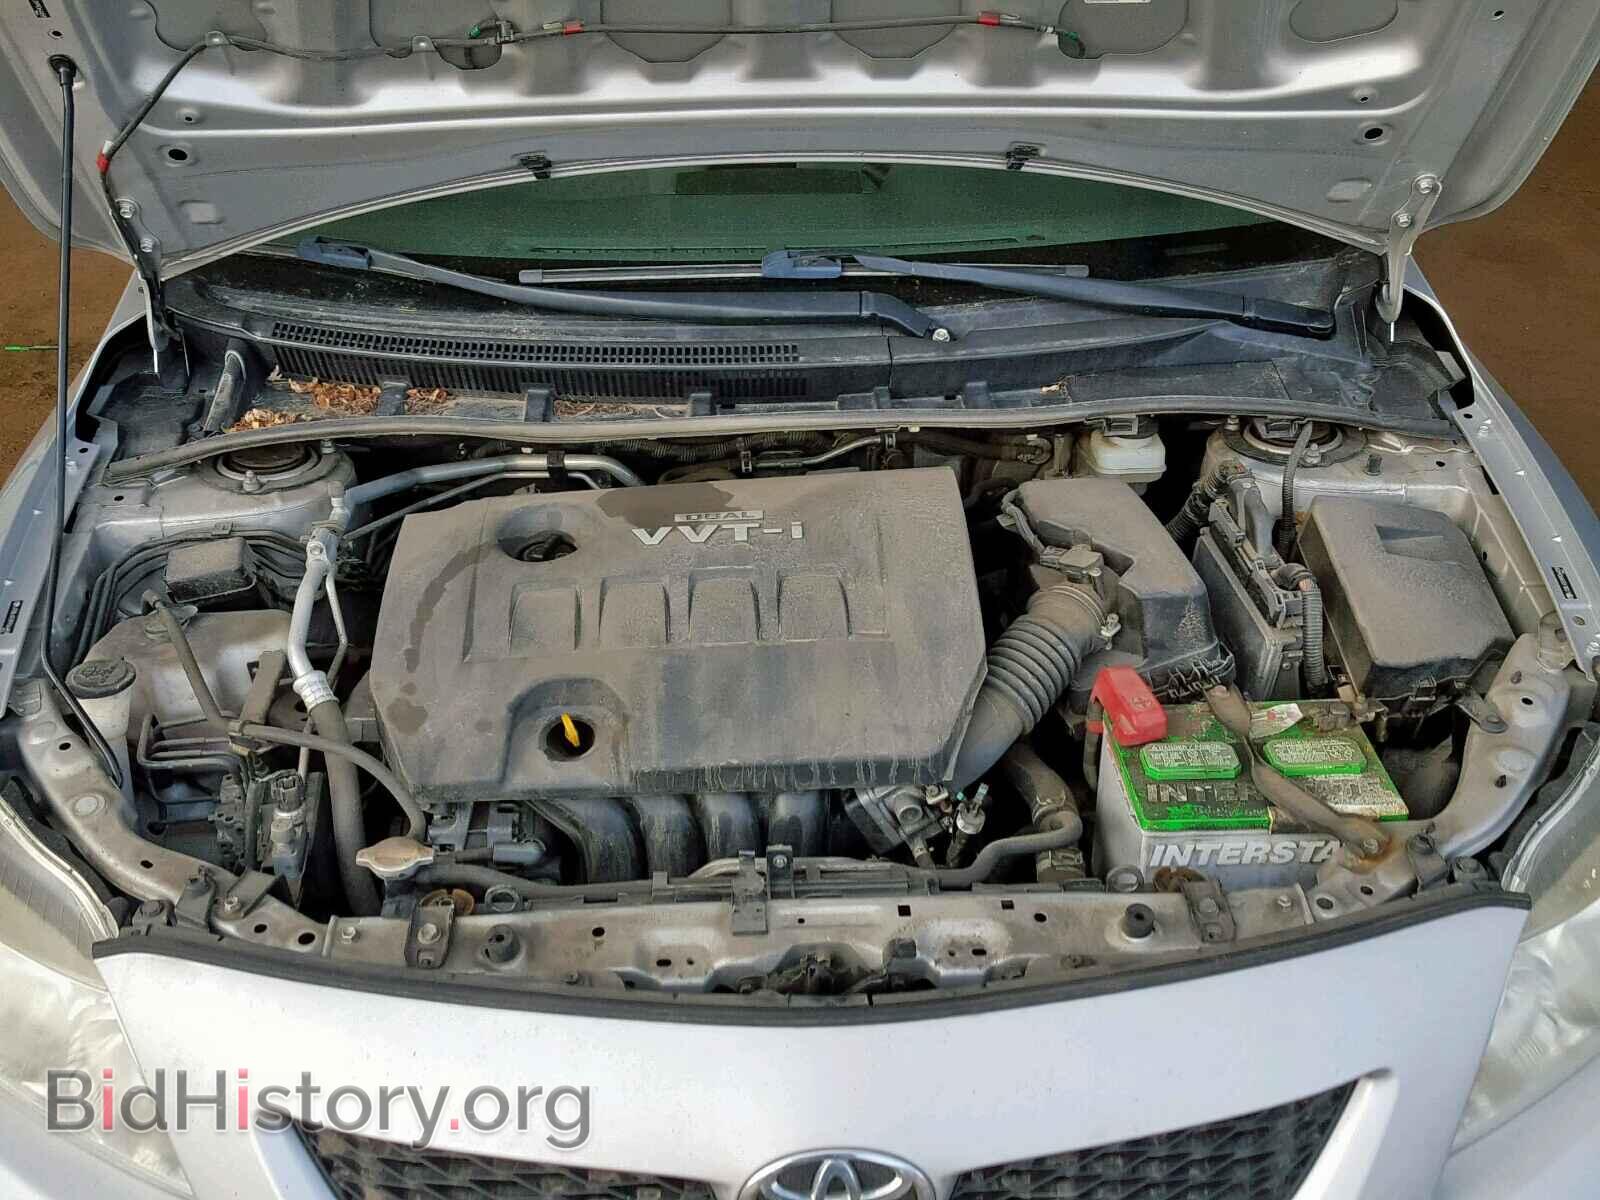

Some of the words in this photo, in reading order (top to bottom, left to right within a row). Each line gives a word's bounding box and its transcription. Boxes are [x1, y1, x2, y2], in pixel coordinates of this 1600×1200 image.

[682, 511, 758, 521] DUAL
[631, 521, 803, 545] VVT-i
[1150, 840, 1341, 867] INTERSTA
